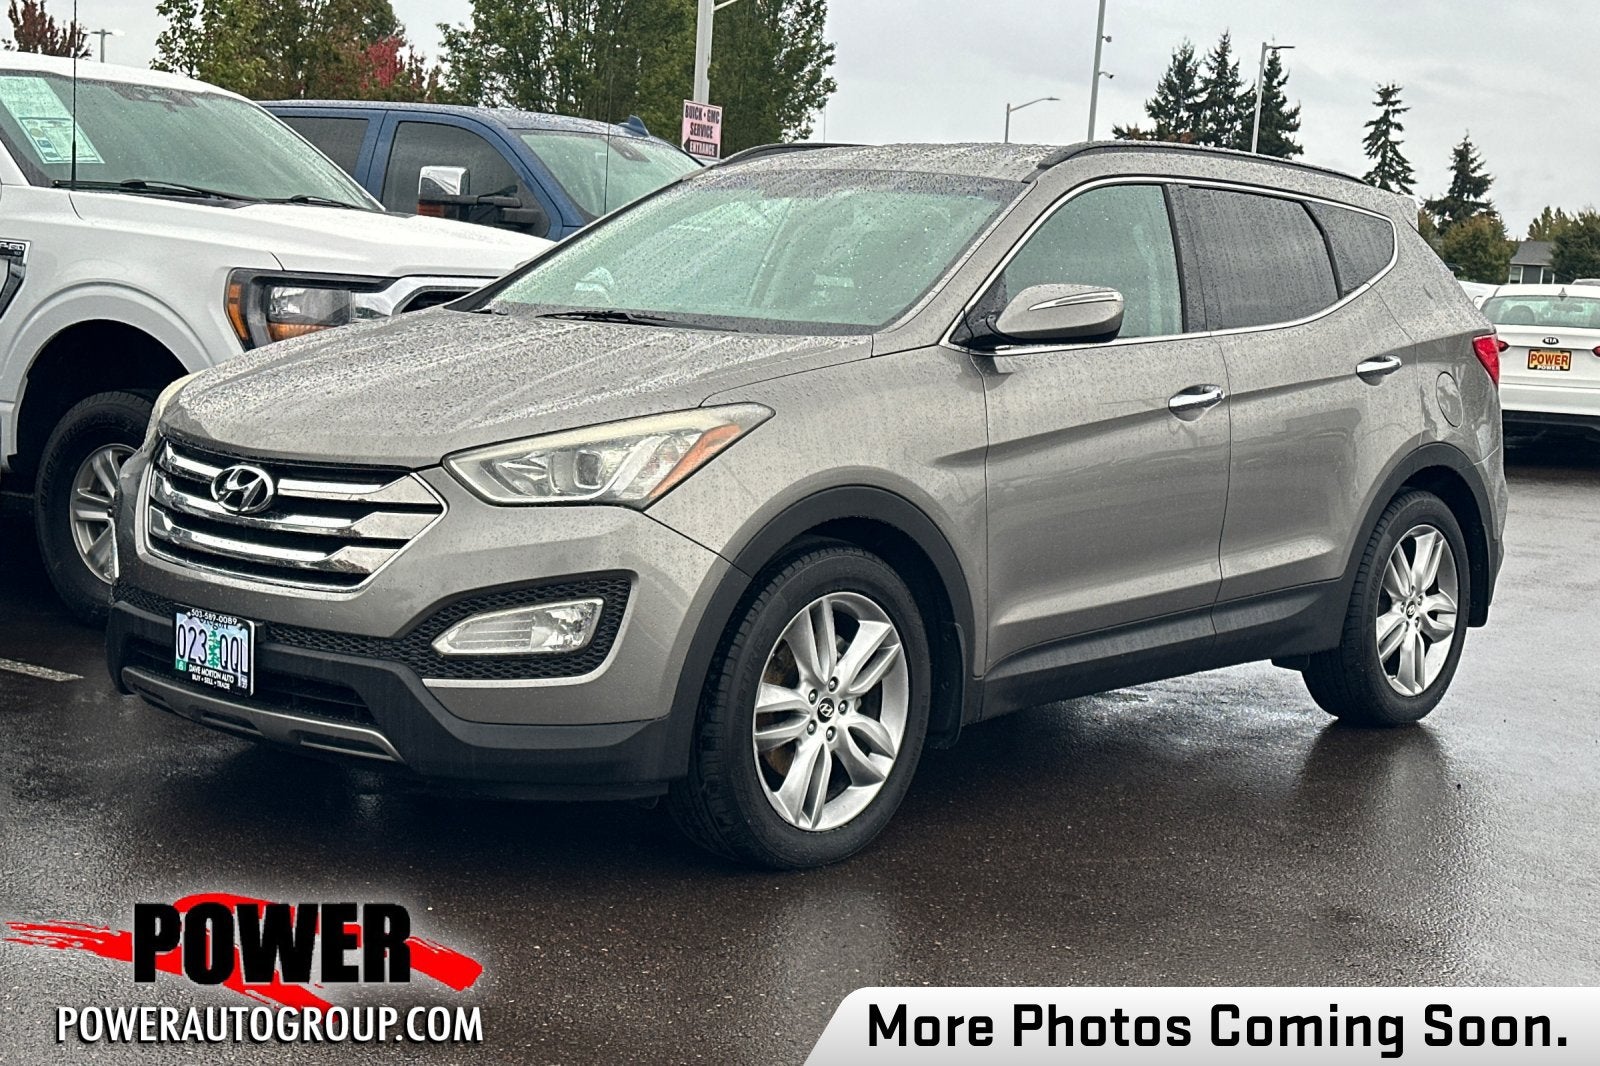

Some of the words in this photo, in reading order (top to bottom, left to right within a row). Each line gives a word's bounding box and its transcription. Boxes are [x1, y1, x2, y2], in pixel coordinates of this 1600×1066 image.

[685, 105, 703, 120] BUICK
[707, 109, 720, 124] GMC
[690, 122, 713, 139] SERVICE
[690, 141, 715, 155] ENTRANCE
[1530, 354, 1568, 365] POWER
[178, 624, 207, 665] 023
[189, 664, 201, 674] DAVE
[201, 667, 221, 680] MORTON
[222, 674, 234, 684] AUTO
[204, 677, 214, 686] SELL
[217, 680, 230, 690] TRADE
